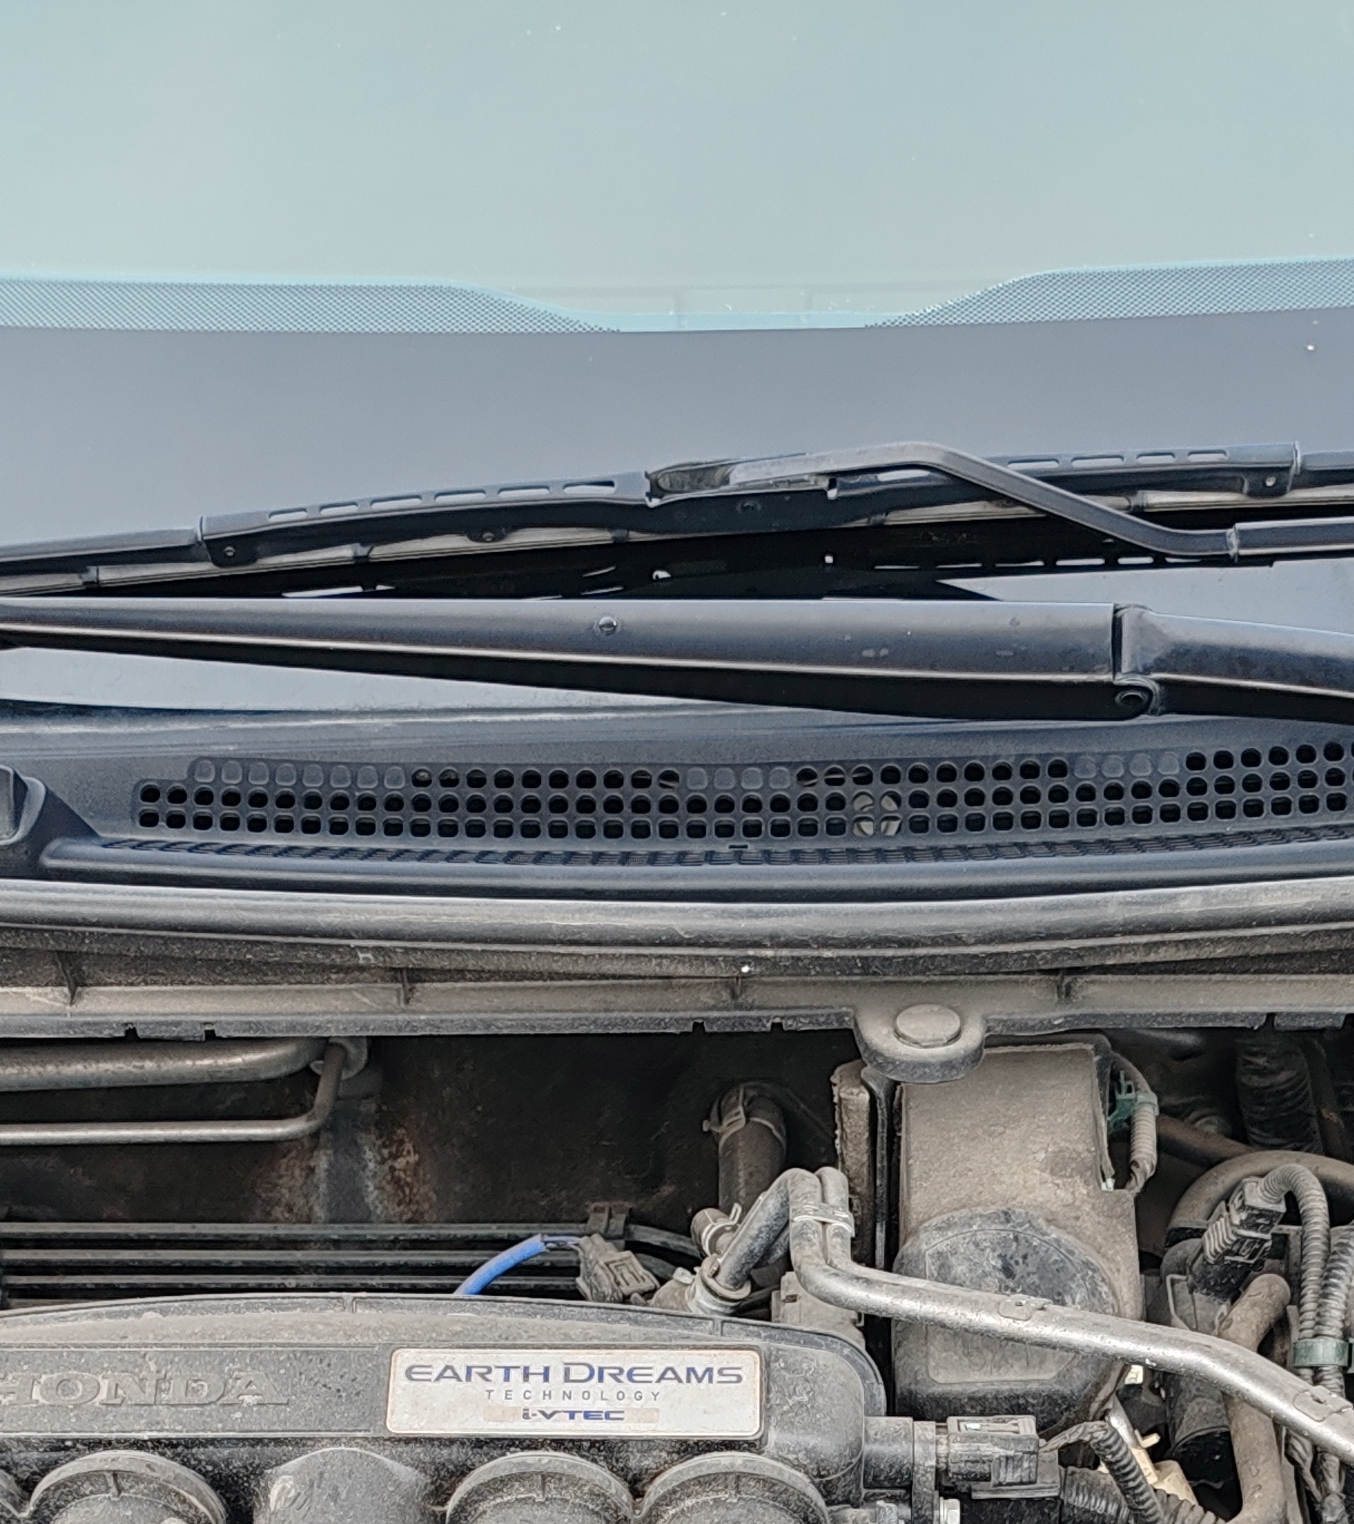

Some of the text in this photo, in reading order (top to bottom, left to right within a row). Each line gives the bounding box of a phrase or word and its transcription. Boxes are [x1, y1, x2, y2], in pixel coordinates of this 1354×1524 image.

[404, 1361, 743, 1384] EARTH DREAMS
[485, 1388, 661, 1401] TECHNOLOGY
